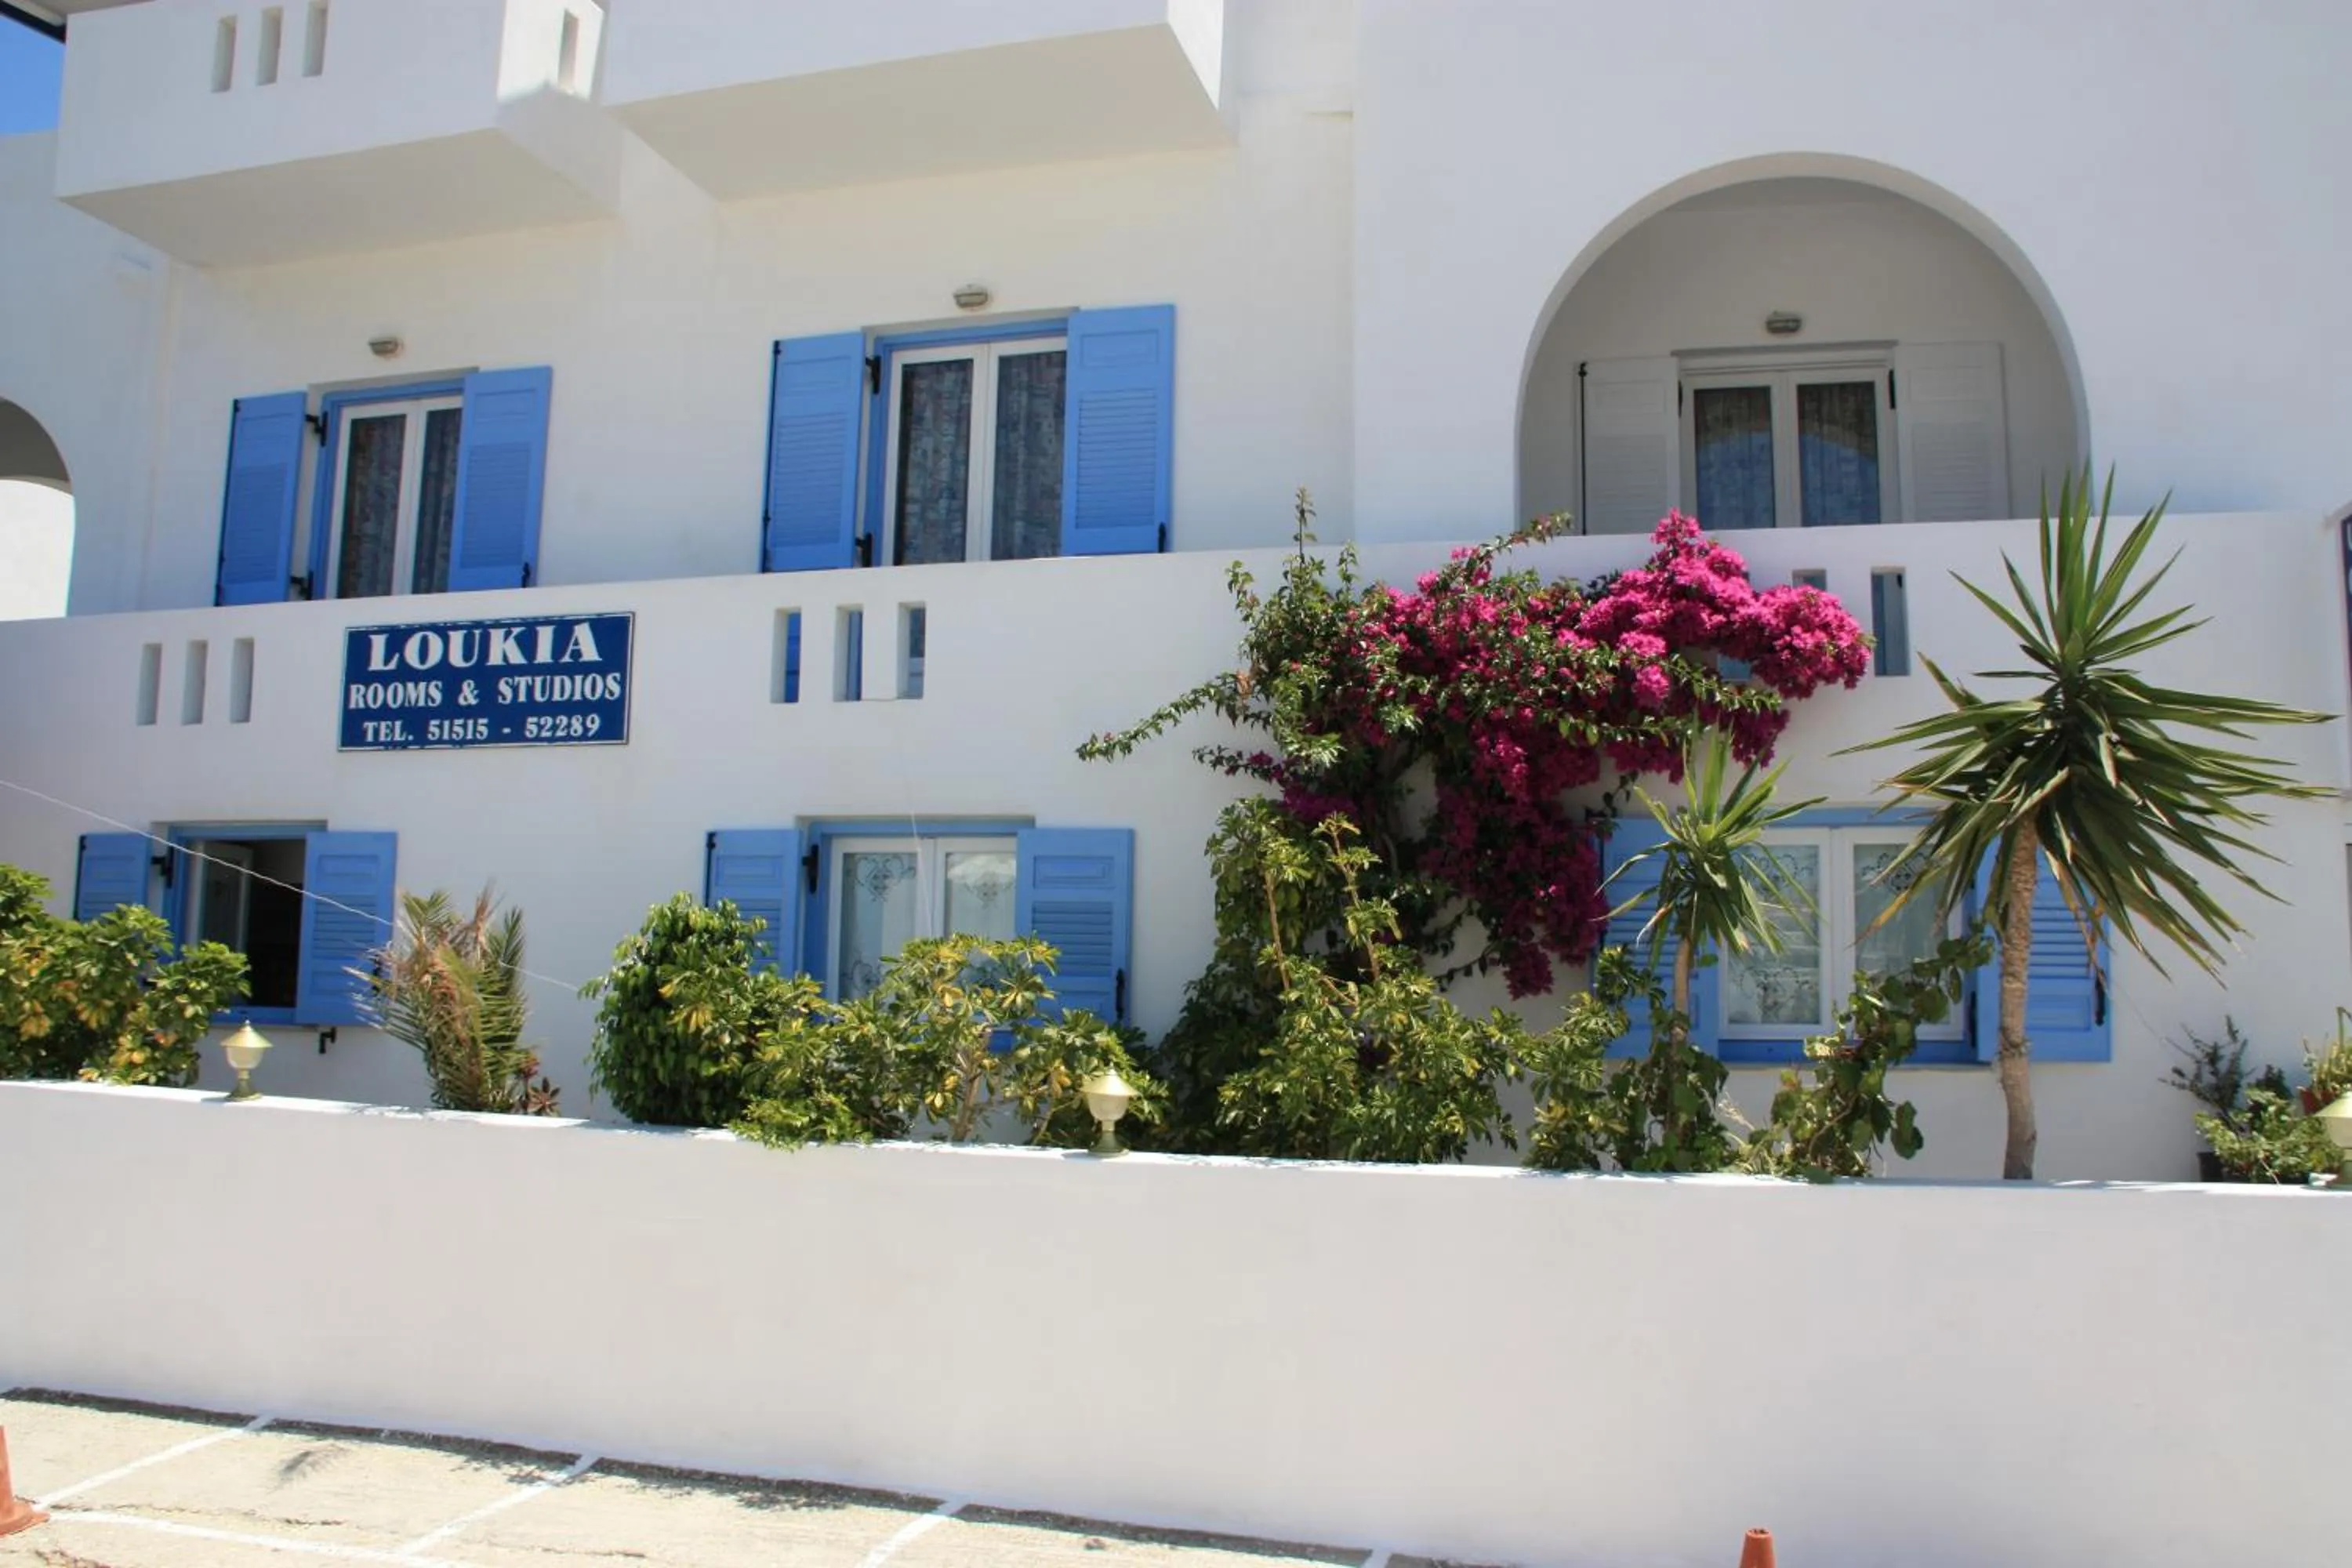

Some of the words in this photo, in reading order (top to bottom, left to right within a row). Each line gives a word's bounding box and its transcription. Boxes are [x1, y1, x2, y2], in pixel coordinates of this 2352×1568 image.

[368, 622, 602, 672] LOUKIA
[349, 681, 442, 709] ROOMS
[458, 680, 480, 706] &
[498, 673, 621, 705] STUDIOS
[364, 720, 413, 742] TEL.
[426, 717, 489, 741] 51515
[524, 713, 601, 738] 52289
